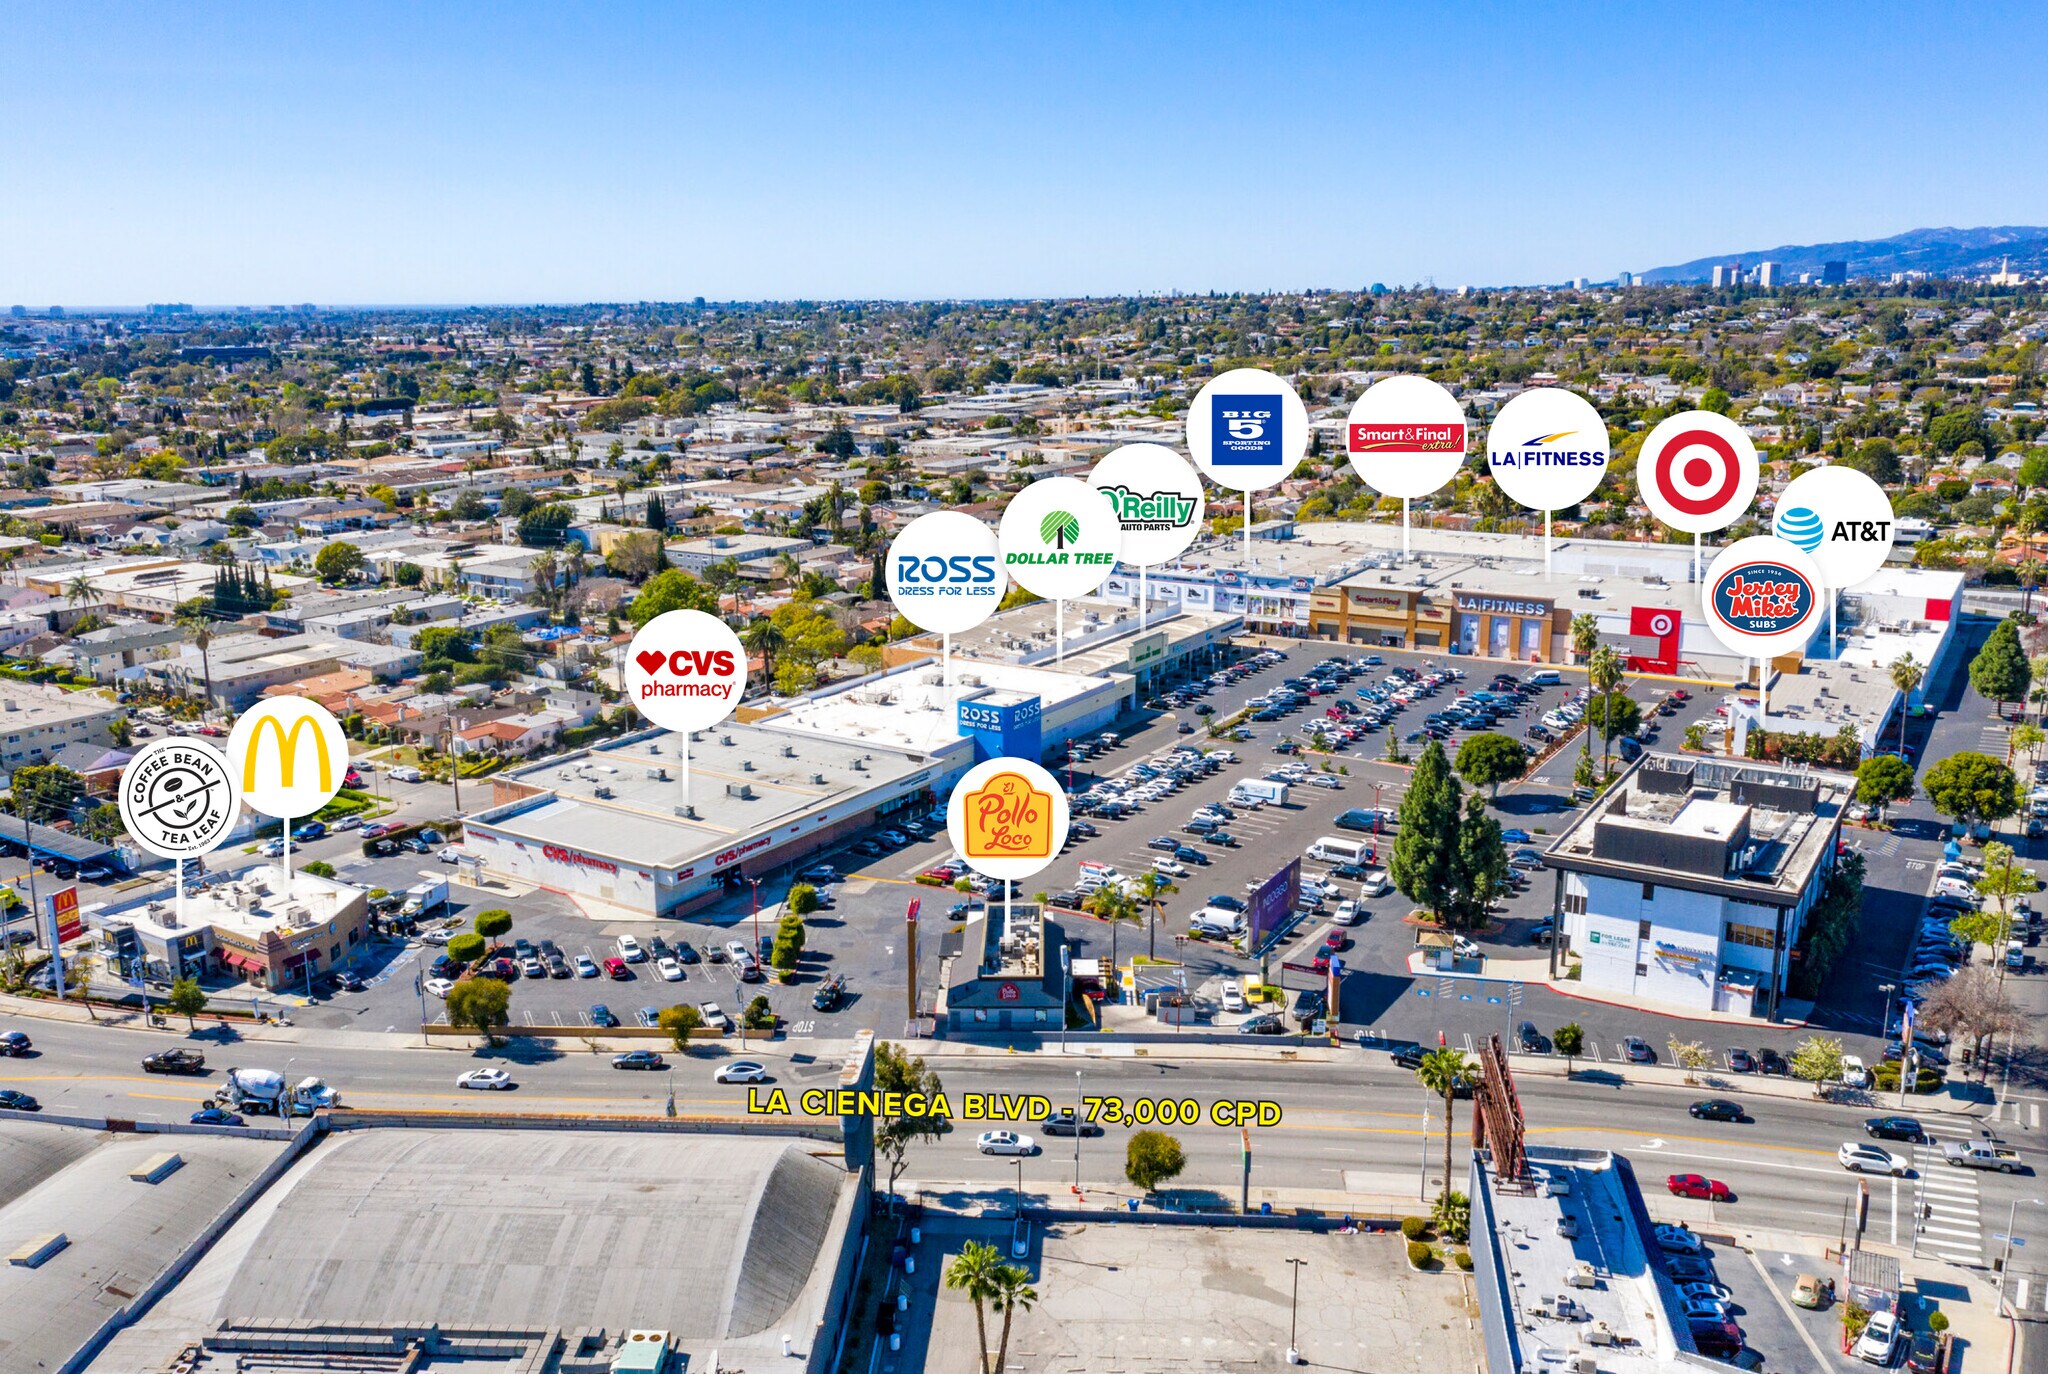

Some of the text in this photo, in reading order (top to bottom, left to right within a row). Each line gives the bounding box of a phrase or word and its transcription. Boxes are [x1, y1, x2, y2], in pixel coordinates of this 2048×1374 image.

[961, 706, 1000, 724] ROSS
[1905, 861, 1927, 871] STOP
[792, 1020, 816, 1033] STOP
